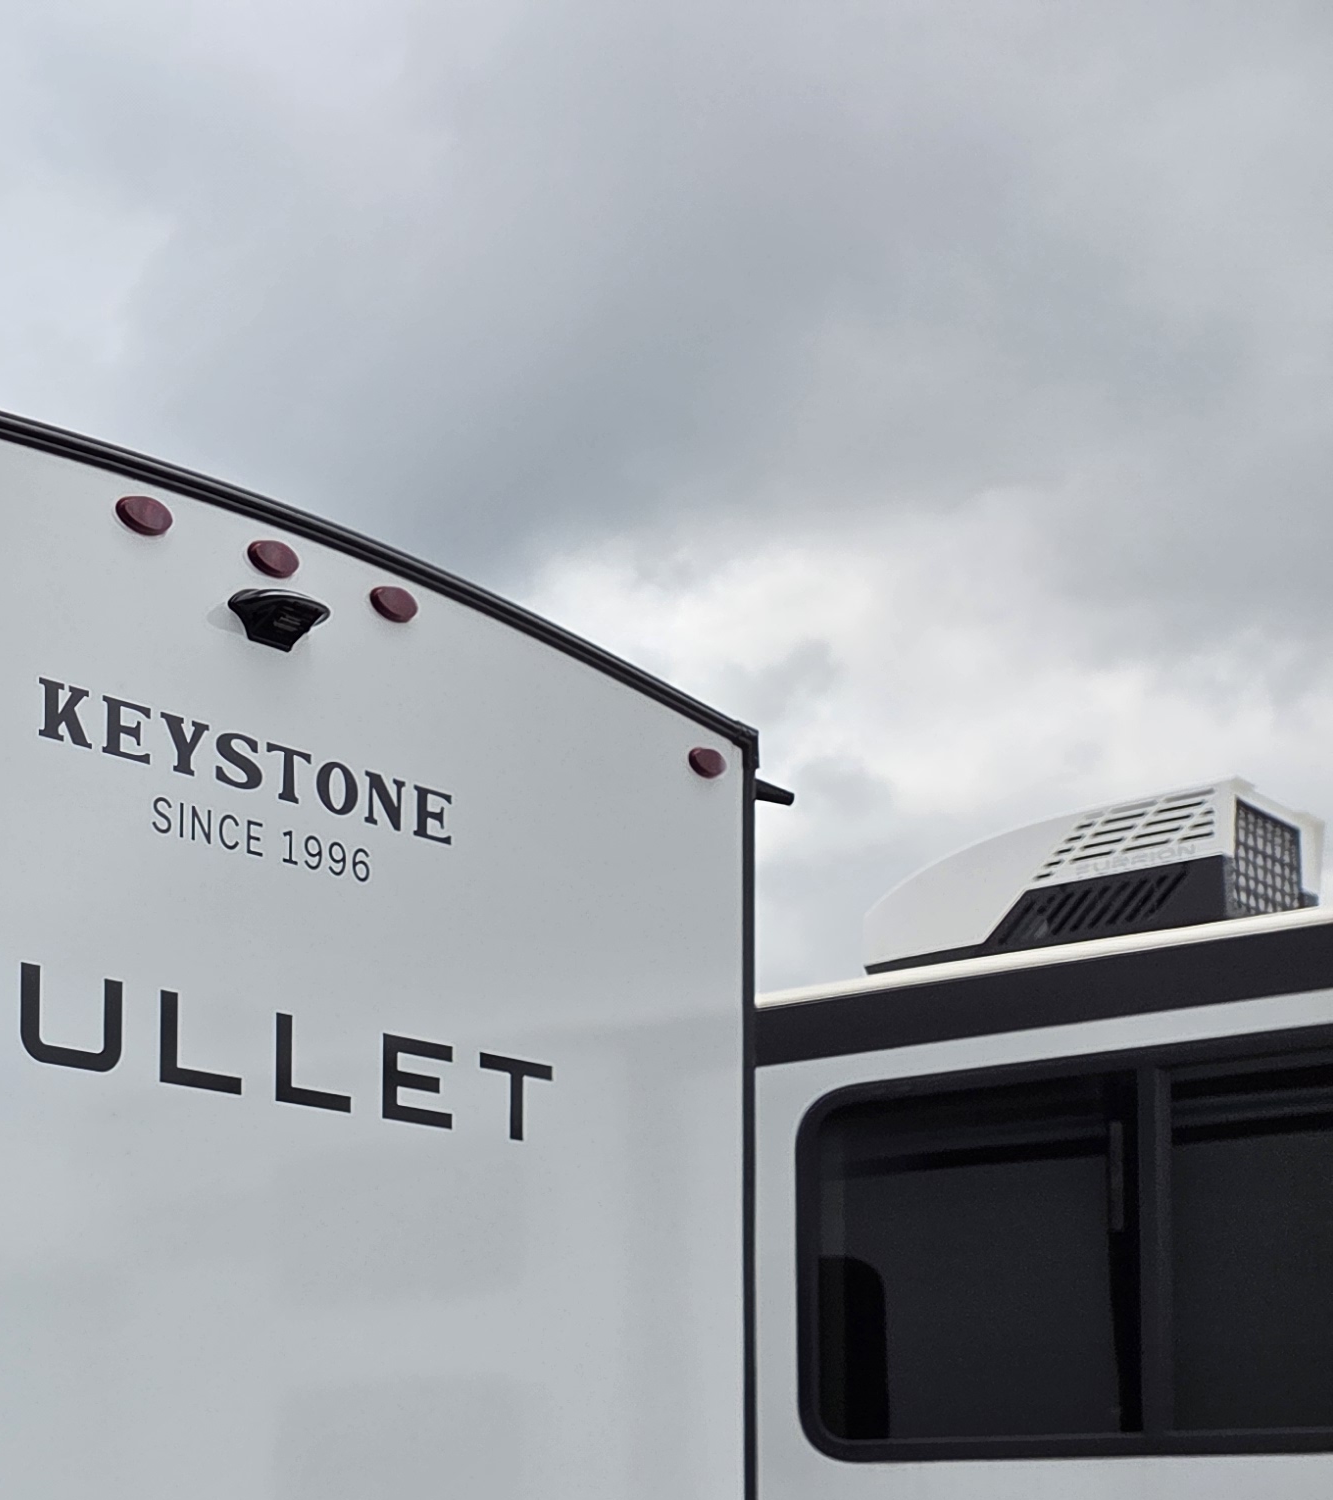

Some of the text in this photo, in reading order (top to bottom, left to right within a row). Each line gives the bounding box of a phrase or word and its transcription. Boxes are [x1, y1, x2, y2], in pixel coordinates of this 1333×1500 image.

[38, 677, 453, 846] KEYSTONE
[151, 797, 372, 882] SINCE 1996
